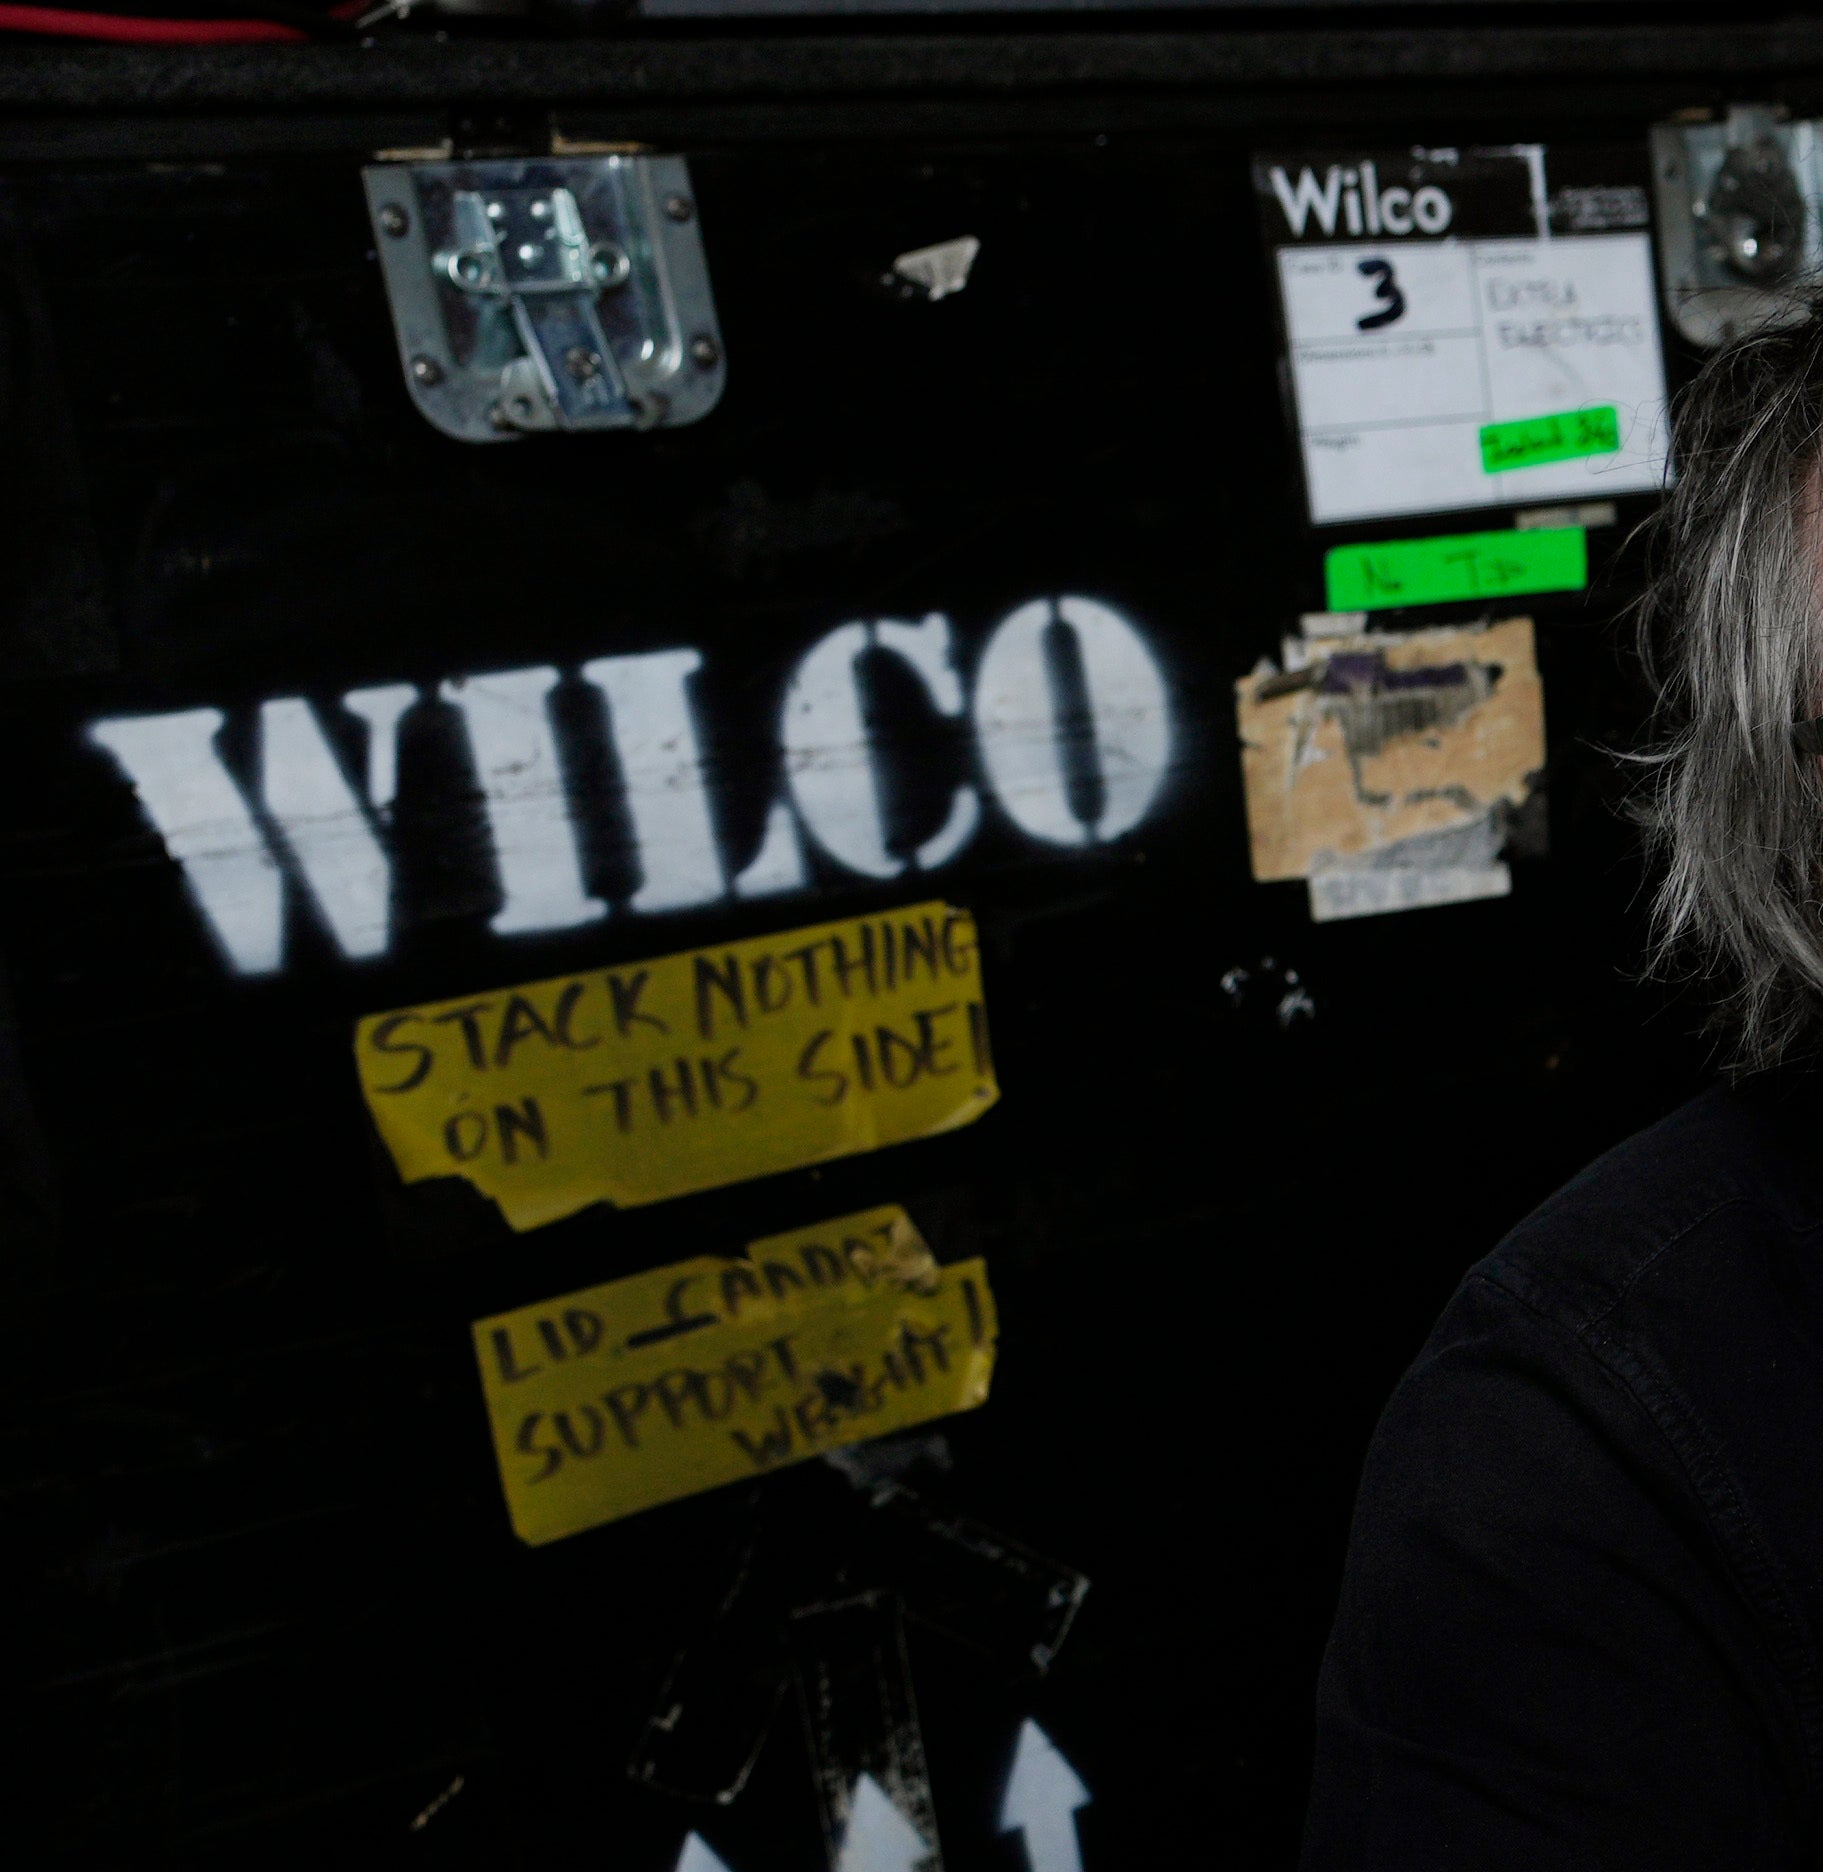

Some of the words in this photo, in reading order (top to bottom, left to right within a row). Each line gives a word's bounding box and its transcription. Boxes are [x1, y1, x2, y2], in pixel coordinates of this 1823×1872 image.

[1271, 160, 1452, 236] Wilco
[1356, 258, 1406, 332] 3
[86, 596, 1172, 973] WILCO
[372, 971, 669, 1094] STACK
[694, 913, 979, 1038] NOTHING
[443, 1094, 550, 1166] ON
[584, 1047, 758, 1135] THIS
[491, 1308, 606, 1385] LID
